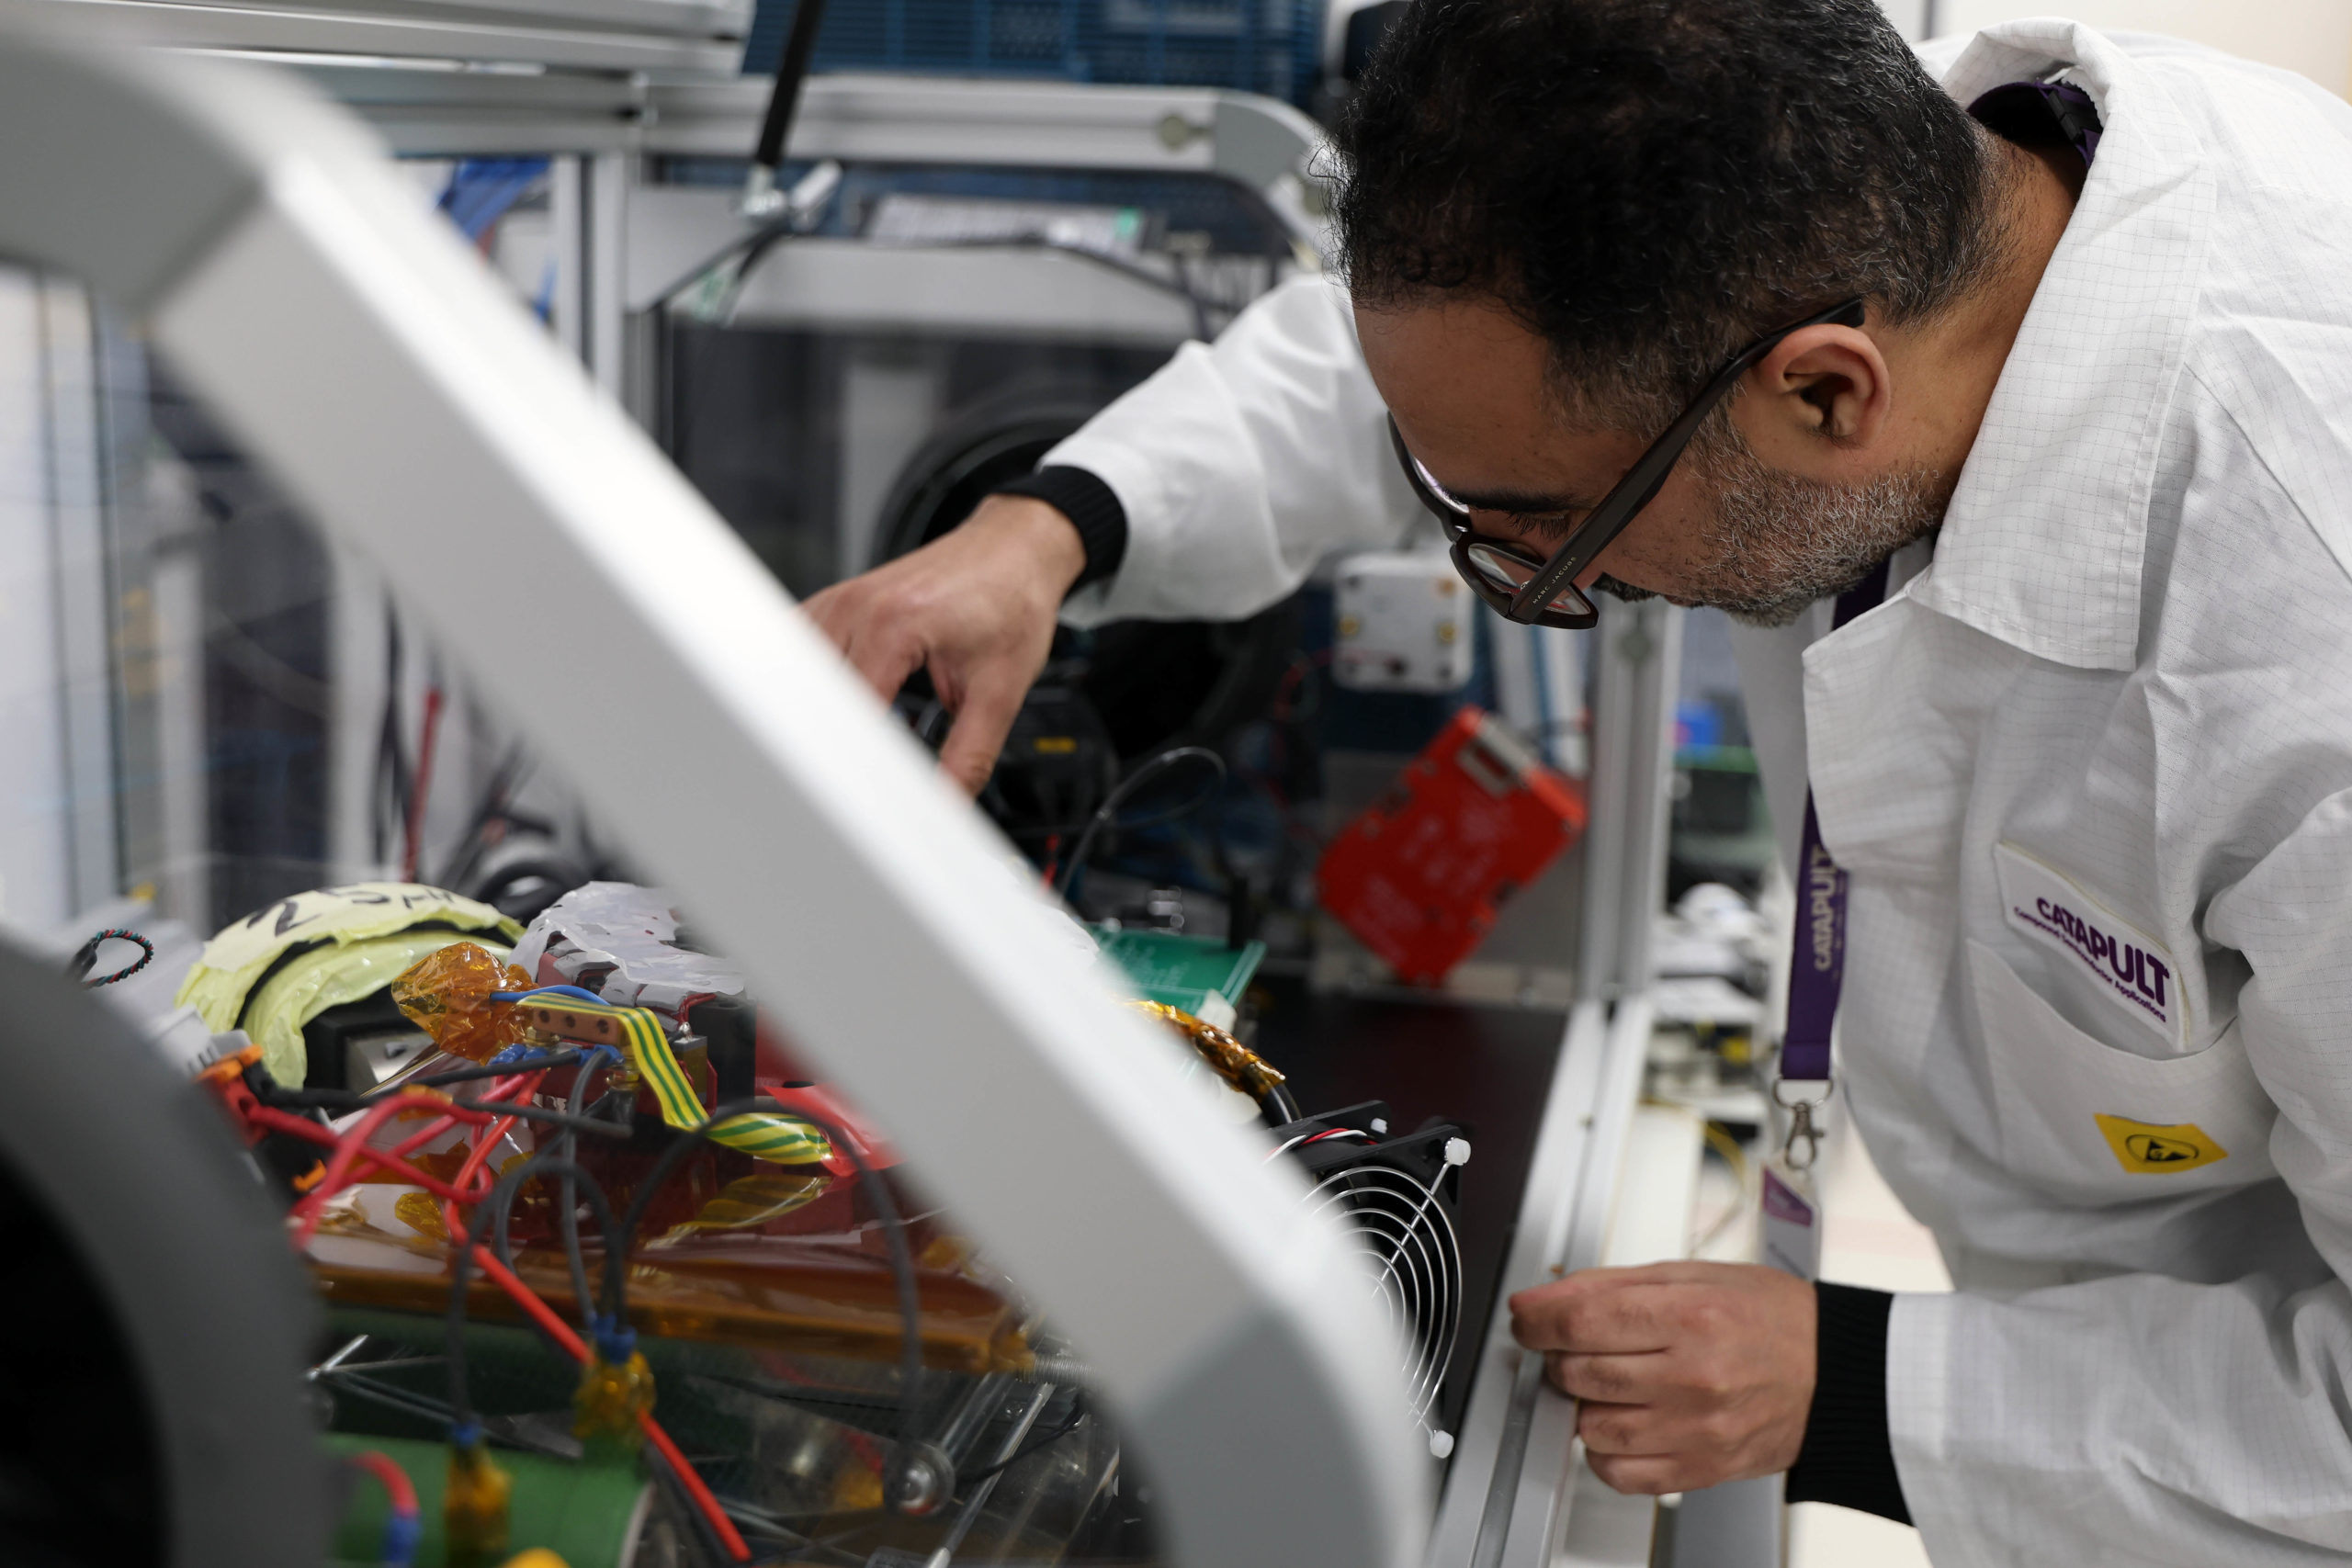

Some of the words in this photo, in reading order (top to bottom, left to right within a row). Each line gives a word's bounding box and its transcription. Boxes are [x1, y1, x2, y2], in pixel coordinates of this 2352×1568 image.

[1532, 585, 1550, 604] MARC
[1552, 557, 1577, 584] JACOBS
[1810, 843, 1838, 972] CATAPULT
[2036, 896, 2170, 1008] CATAPULT
[2115, 979, 2167, 1023] Applications
